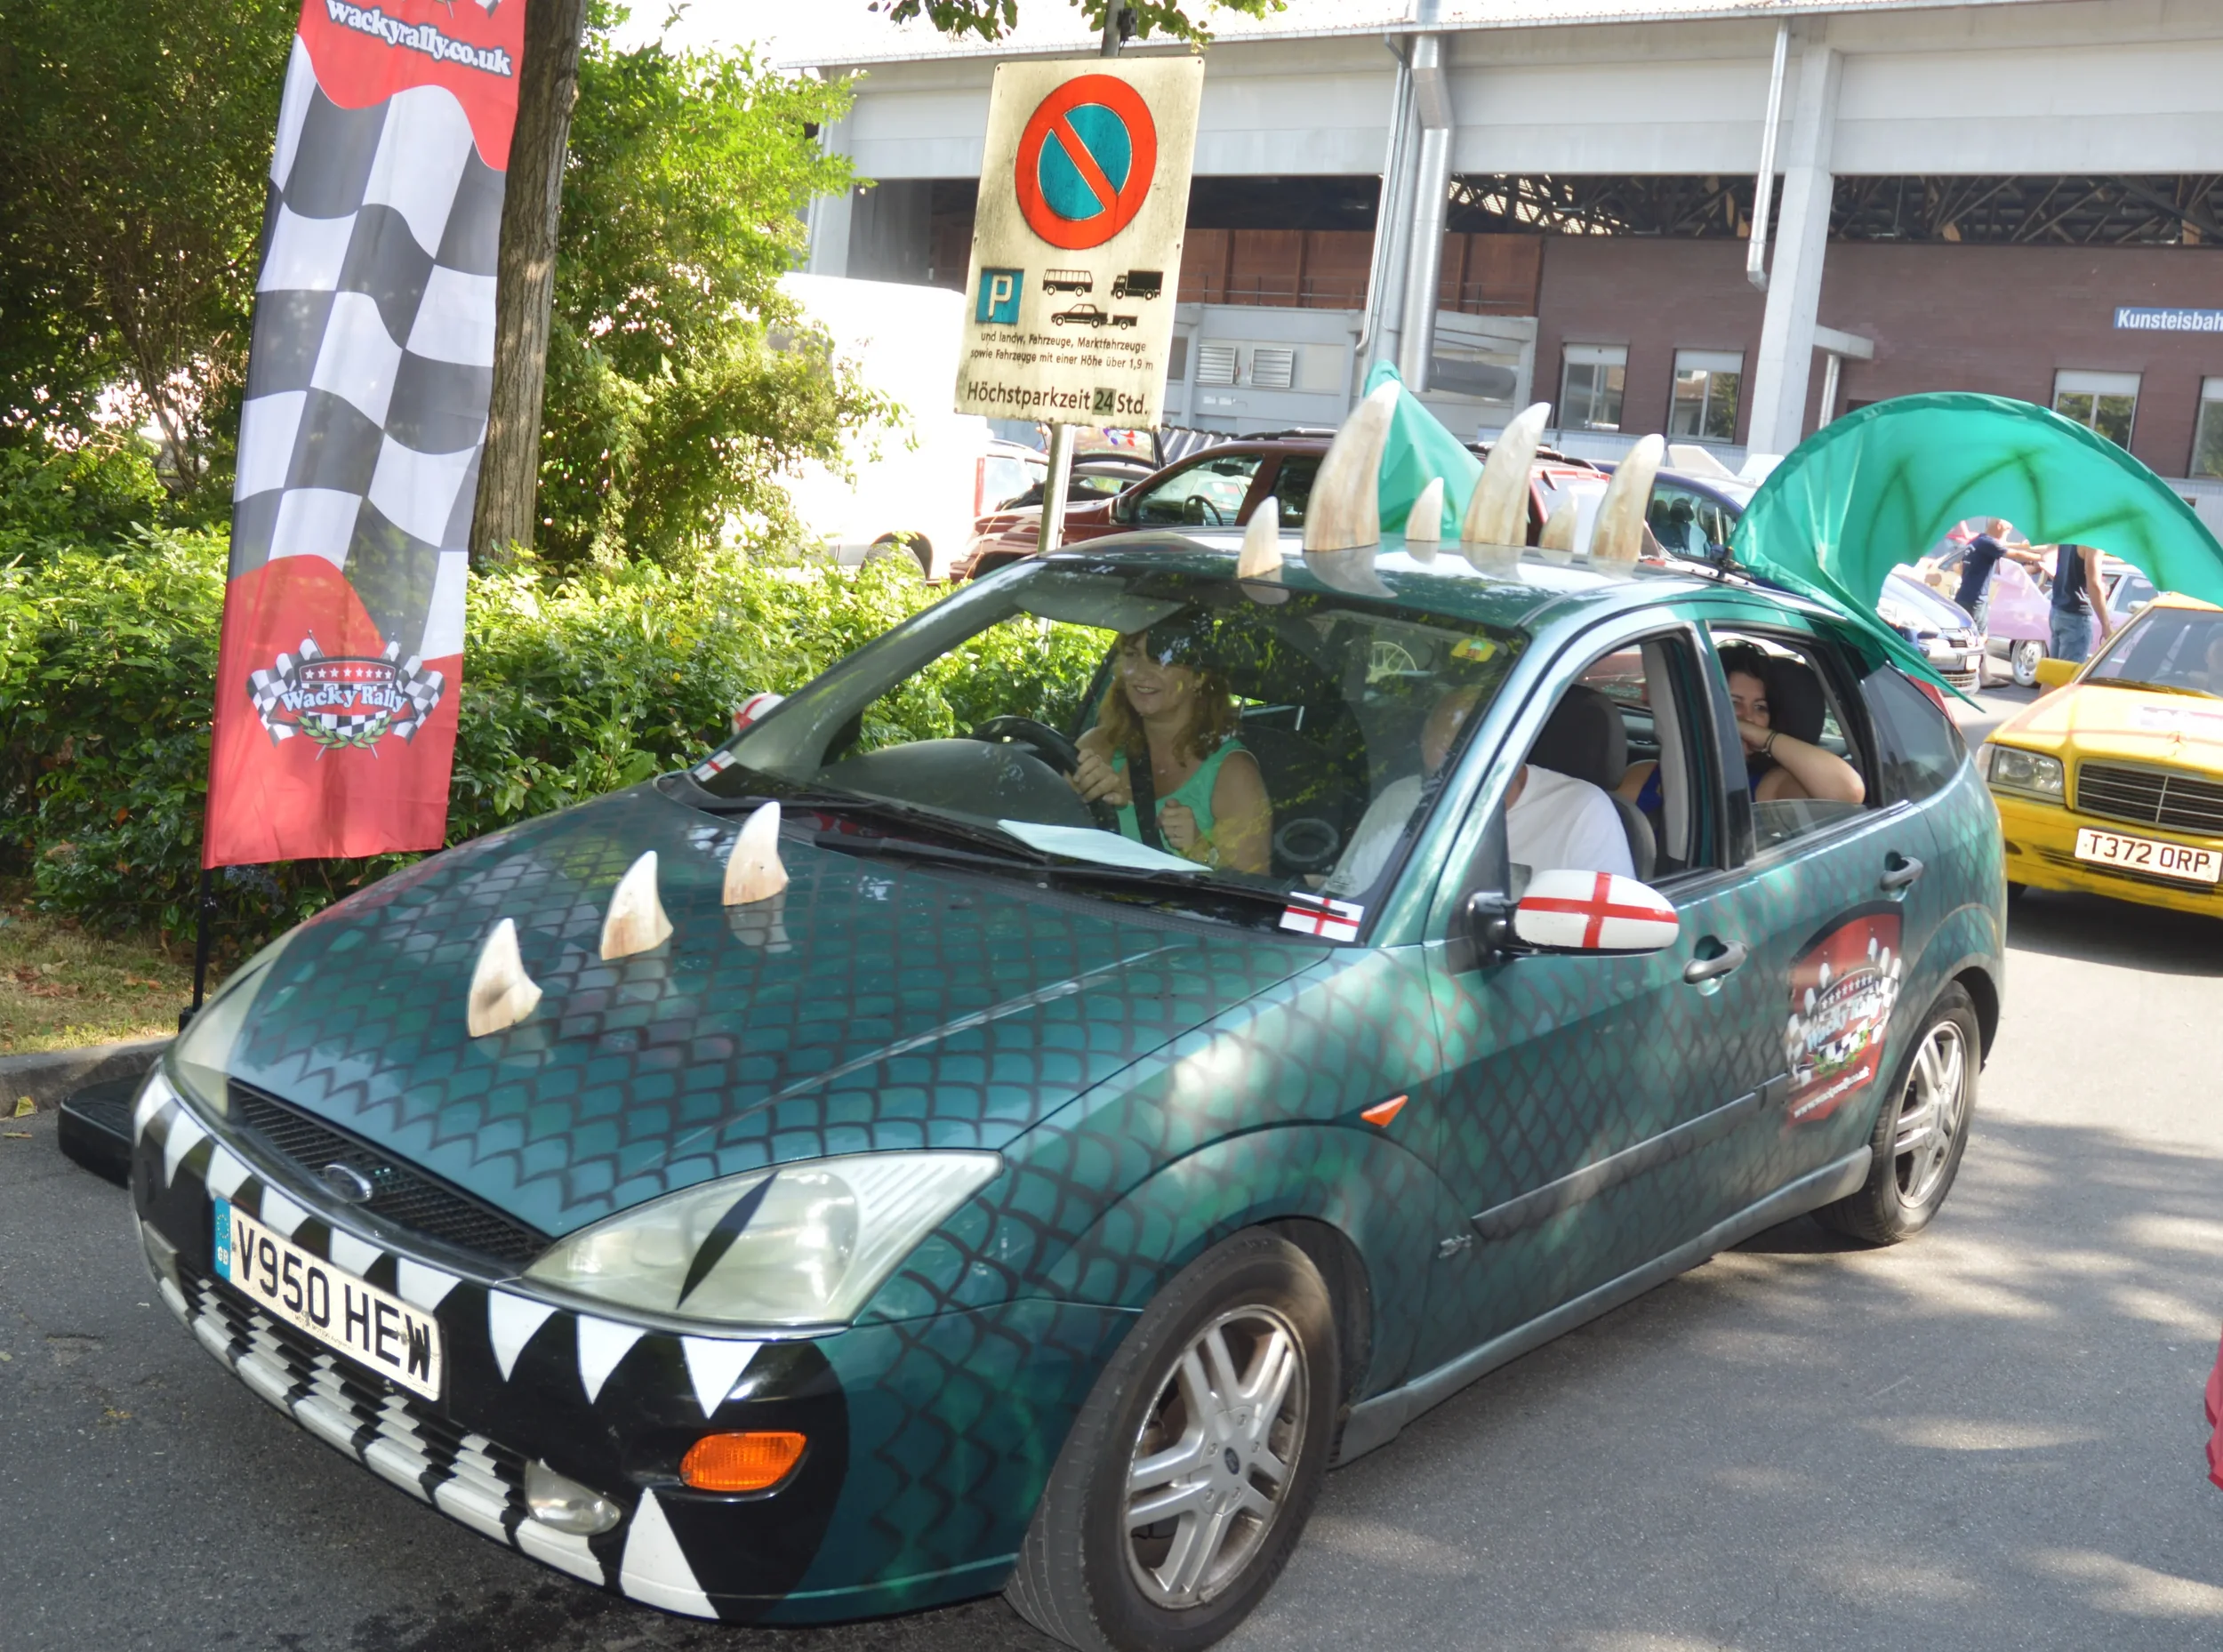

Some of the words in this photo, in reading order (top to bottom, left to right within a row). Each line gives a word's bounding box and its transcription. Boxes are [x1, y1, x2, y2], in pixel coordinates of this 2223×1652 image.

[325, 0, 512, 76] wackyrally.co.uk
[988, 274, 1013, 318] P
[971, 348, 993, 359] sowie
[995, 349, 1037, 365] Fahrzeuge
[1039, 352, 1054, 363] mit
[1055, 353, 1078, 365] einer
[1080, 354, 1103, 366] Höhe
[1106, 356, 1127, 368] über
[1129, 357, 1143, 371] 1,9
[1145, 361, 1153, 371] m
[981, 331, 997, 342] und
[1029, 333, 1074, 349] Fahrzeuge,
[1077, 337, 1146, 354] Marktfahrzeuge
[967, 381, 1091, 410] Höchstparkzeit
[1094, 390, 1114, 413] 24
[1117, 392, 1148, 415] Std.
[280, 685, 357, 711] Wacky
[360, 685, 407, 712] Rally
[2090, 834, 2153, 864] T372
[2159, 846, 2211, 873] ORP
[237, 1220, 330, 1328] V950
[344, 1283, 431, 1383] HEW
